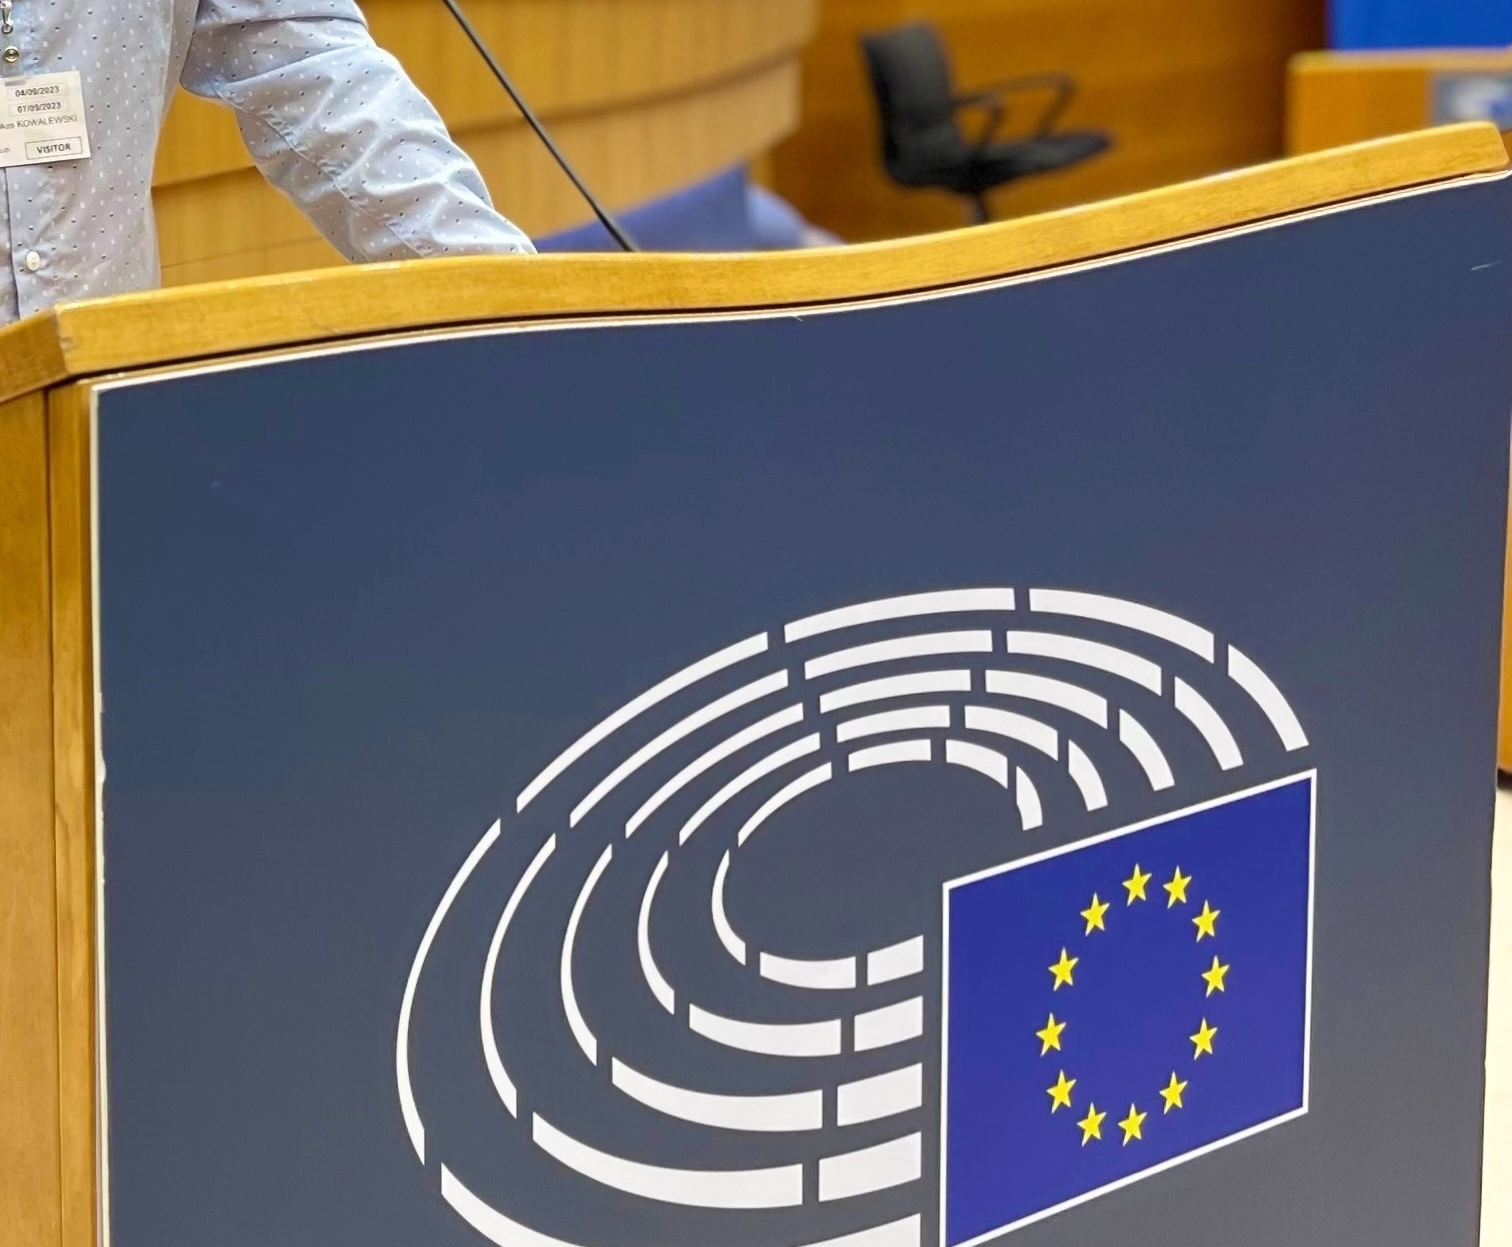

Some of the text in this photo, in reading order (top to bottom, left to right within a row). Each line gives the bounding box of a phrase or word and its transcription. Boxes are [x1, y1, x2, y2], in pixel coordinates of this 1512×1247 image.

[14, 85, 60, 98] 04/09/2023
[17, 101, 62, 114] 07/09/2023
[16, 114, 78, 128] KOWALEWSKI
[36, 142, 72, 154] VISITOR
